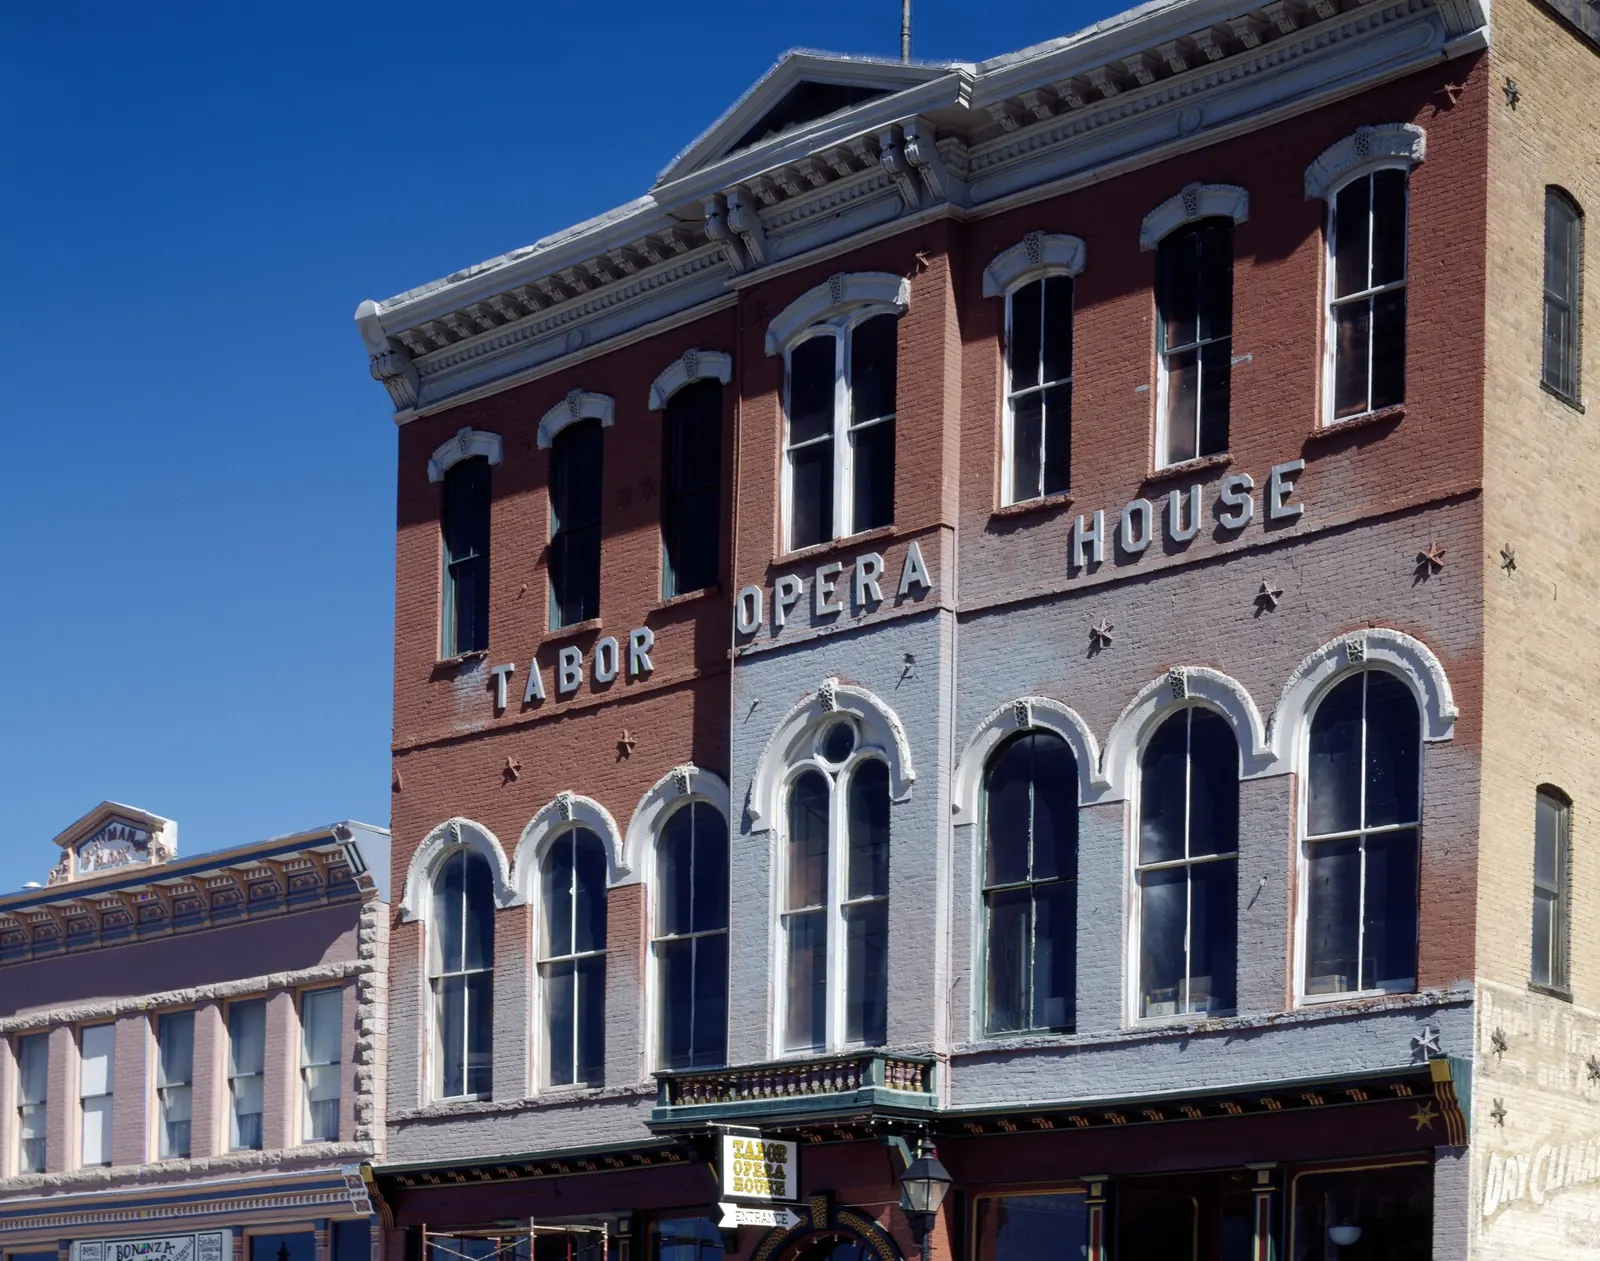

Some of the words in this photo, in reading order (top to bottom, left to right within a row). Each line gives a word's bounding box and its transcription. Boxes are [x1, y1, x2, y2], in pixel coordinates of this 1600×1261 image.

[491, 626, 654, 708] TABOR
[737, 541, 932, 634] OPERA
[1074, 459, 1305, 567] HOUSE
[732, 1140, 788, 1163] TABOR
[733, 1160, 786, 1180] OPERA
[733, 1177, 786, 1196] HOUSE
[735, 1210, 788, 1225] ENTRANCE
